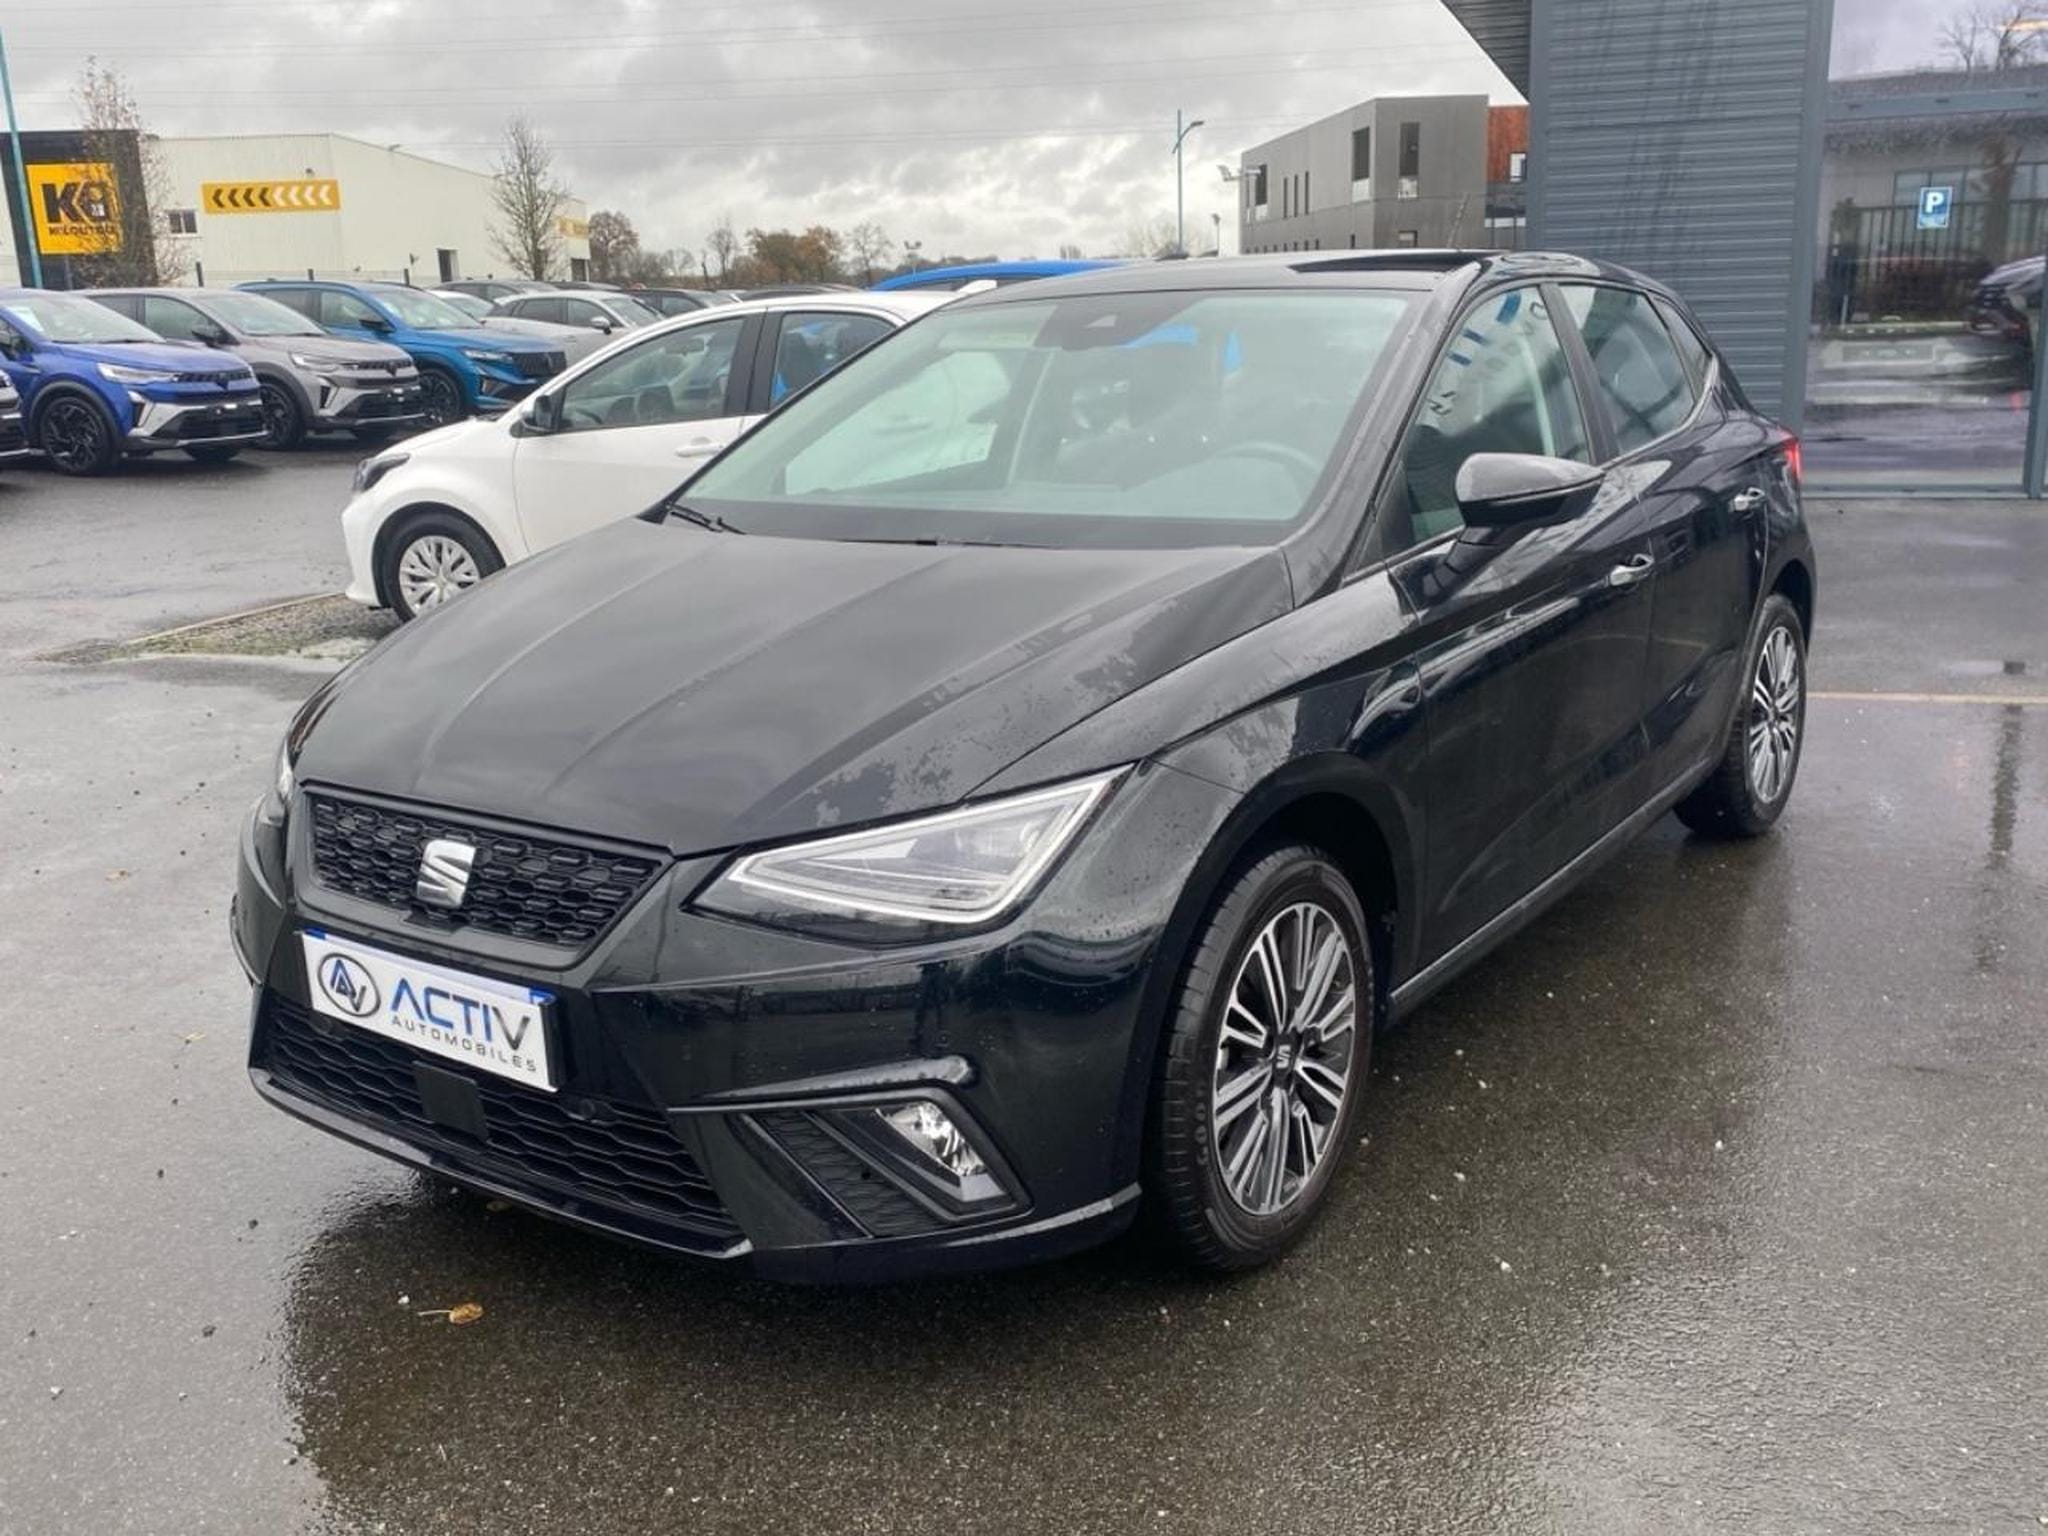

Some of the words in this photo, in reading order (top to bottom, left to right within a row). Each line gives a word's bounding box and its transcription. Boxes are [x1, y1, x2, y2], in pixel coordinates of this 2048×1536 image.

[1925, 191, 1944, 213] P
[390, 977, 531, 1051] ACTIV
[391, 1015, 537, 1073] AUTOMOBILES
